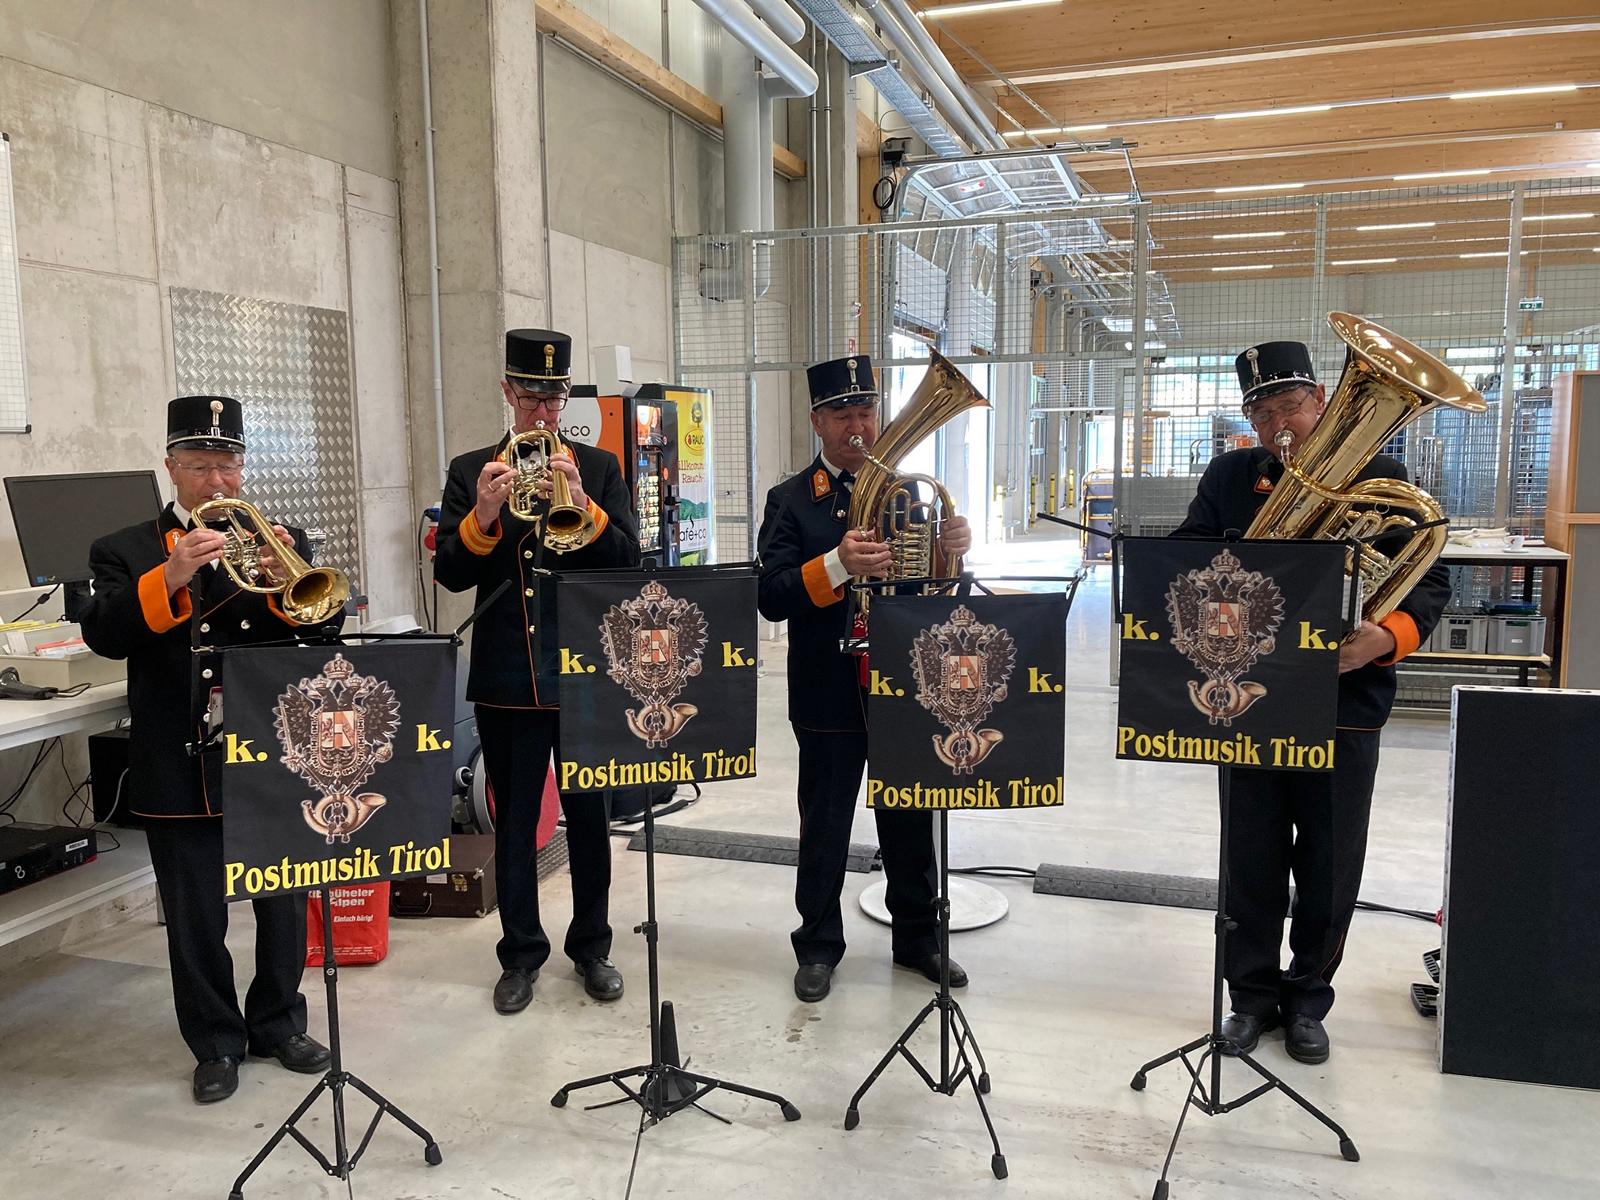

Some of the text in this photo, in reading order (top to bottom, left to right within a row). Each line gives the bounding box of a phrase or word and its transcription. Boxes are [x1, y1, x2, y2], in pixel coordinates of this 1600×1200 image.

[692, 434, 704, 445] RAUC
[1123, 613, 1338, 650] k. k.
[560, 641, 755, 675] k. k.
[868, 667, 1063, 697] k. k.
[224, 723, 452, 764] k. k.
[1117, 726, 1335, 769] Postmusik Tirol
[560, 747, 756, 790] Postmusik Tirol
[867, 776, 1064, 809] Postmusik Tirol
[225, 837, 451, 897] Postmusik Tirol
